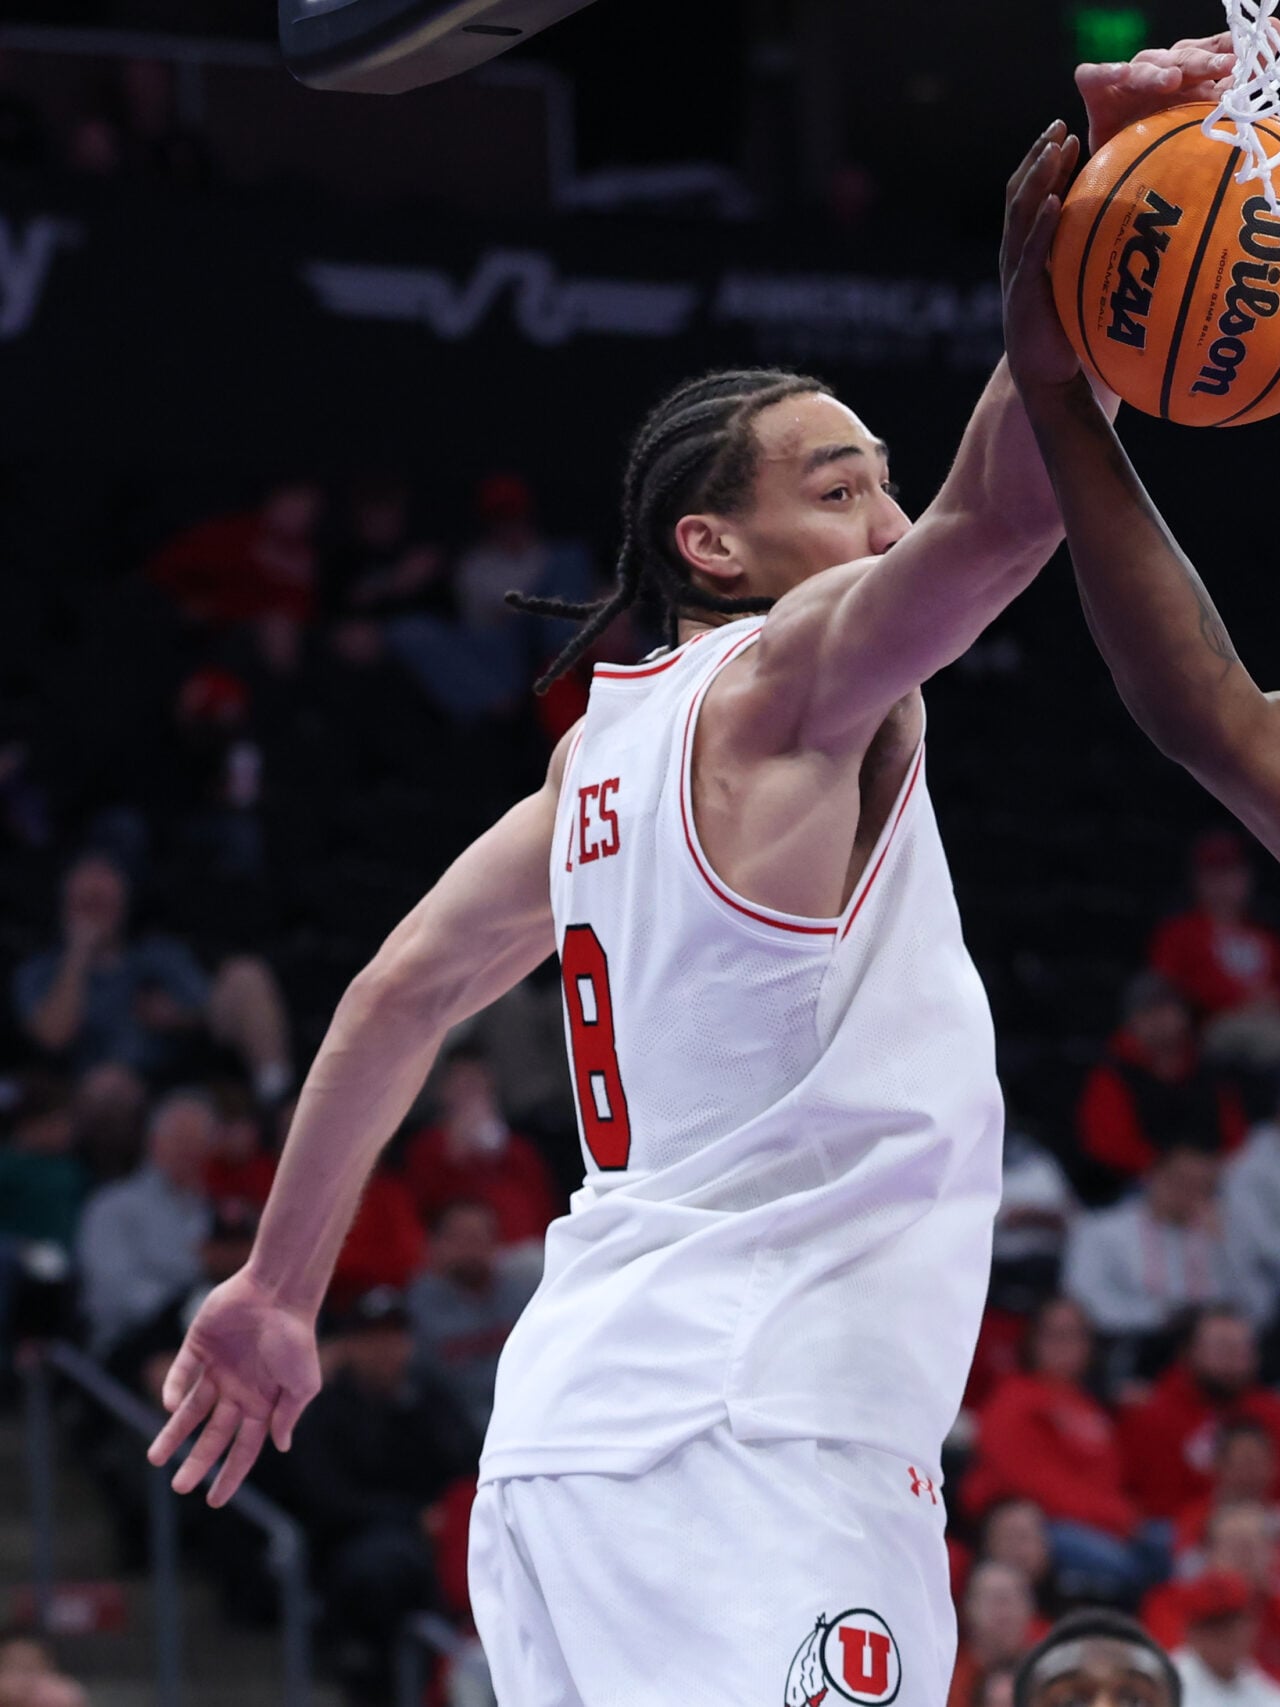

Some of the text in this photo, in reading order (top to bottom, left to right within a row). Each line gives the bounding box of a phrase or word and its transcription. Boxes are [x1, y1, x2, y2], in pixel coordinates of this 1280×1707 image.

[1106, 189, 1183, 350] NCAA
[1197, 248, 1228, 346] INDOOR GAME BALL
[566, 777, 620, 872] ES
[561, 923, 632, 1172] 8
[838, 1625, 891, 1697] U
